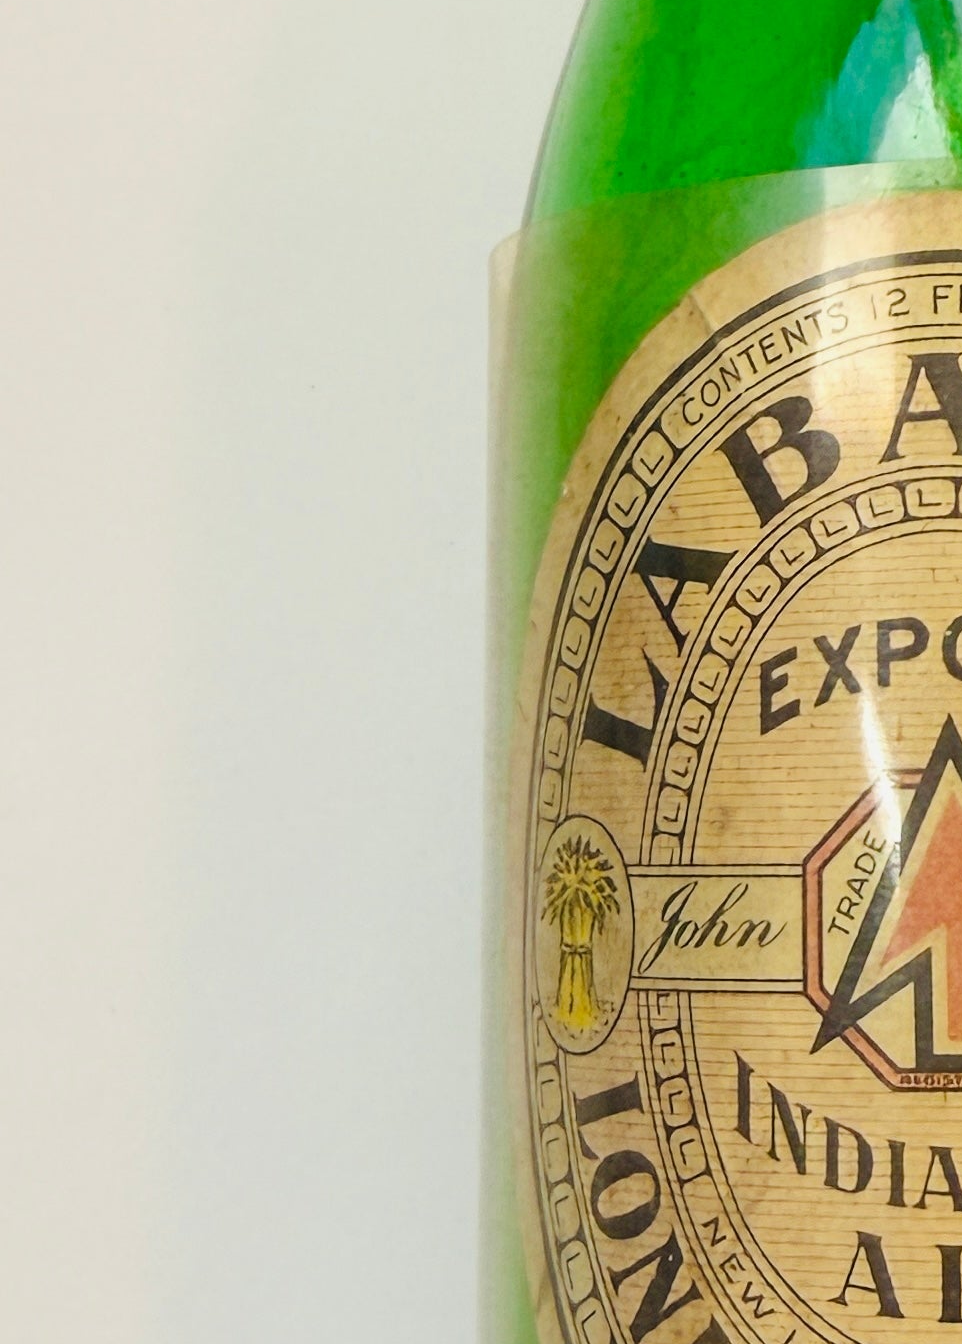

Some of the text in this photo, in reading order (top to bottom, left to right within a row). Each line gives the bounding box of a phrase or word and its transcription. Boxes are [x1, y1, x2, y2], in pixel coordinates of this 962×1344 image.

[681, 300, 850, 427] CONTENTS
[870, 289, 911, 320] 12
[637, 881, 788, 976] John
[828, 829, 886, 937] TRADE
[701, 1216, 775, 1320] NEW
